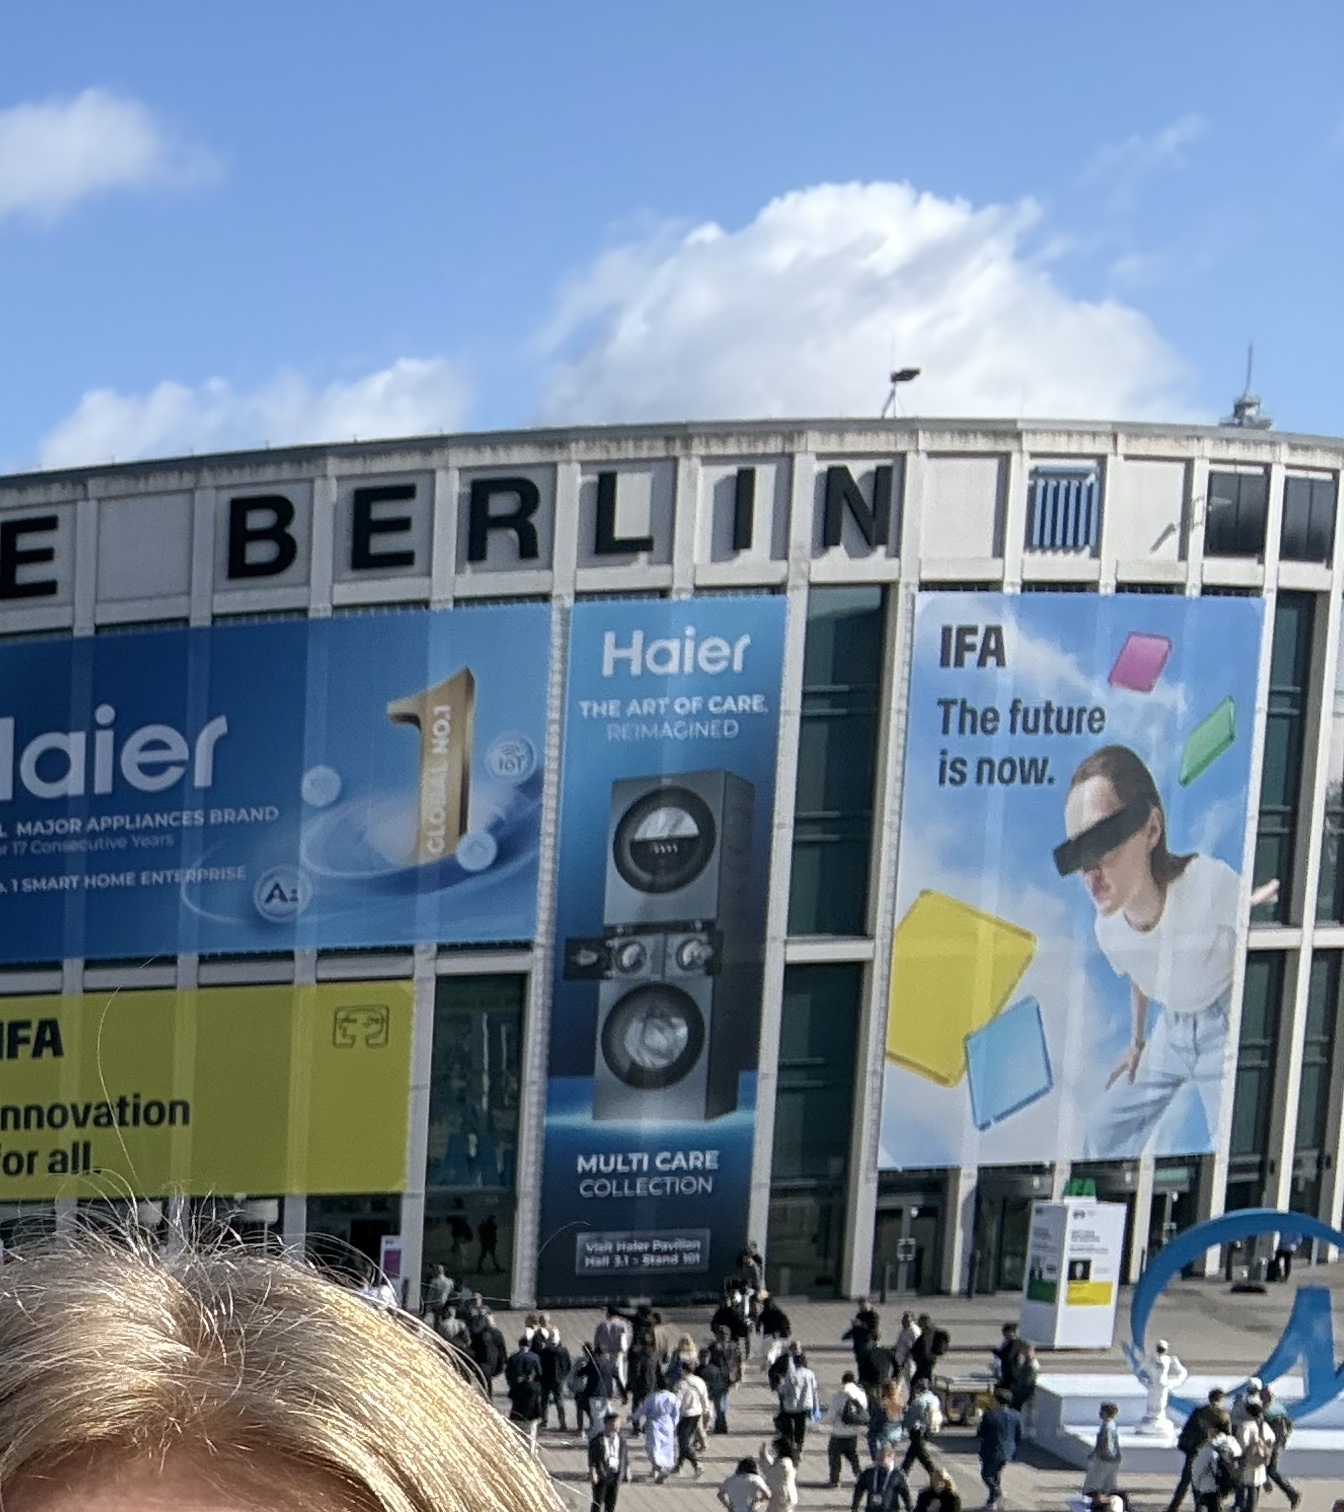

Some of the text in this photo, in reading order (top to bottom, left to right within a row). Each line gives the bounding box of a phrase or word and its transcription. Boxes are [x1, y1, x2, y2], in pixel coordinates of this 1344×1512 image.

[227, 464, 893, 581] BERLIN
[602, 625, 751, 678] Haier
[940, 624, 1006, 668] IFA
[578, 699, 620, 718] THE
[627, 697, 670, 717] ART
[673, 696, 703, 715] OF
[937, 698, 1106, 736] The future
[607, 719, 740, 741] REIMAGINED
[938, 749, 1056, 786] is now.
[16, 817, 82, 837] MAJOR
[86, 809, 204, 832] APPLIANCES
[209, 806, 279, 826] BRAND
[30, 835, 128, 855] Consecutive
[131, 833, 175, 848] Years
[22, 875, 79, 892] SMART
[84, 871, 135, 889] HOME
[140, 865, 247, 885] ENTERPRISE
[46, 1140, 102, 1175] all.
[576, 1150, 720, 1174] MULTI CARE
[579, 1176, 713, 1198] COLLECTION
